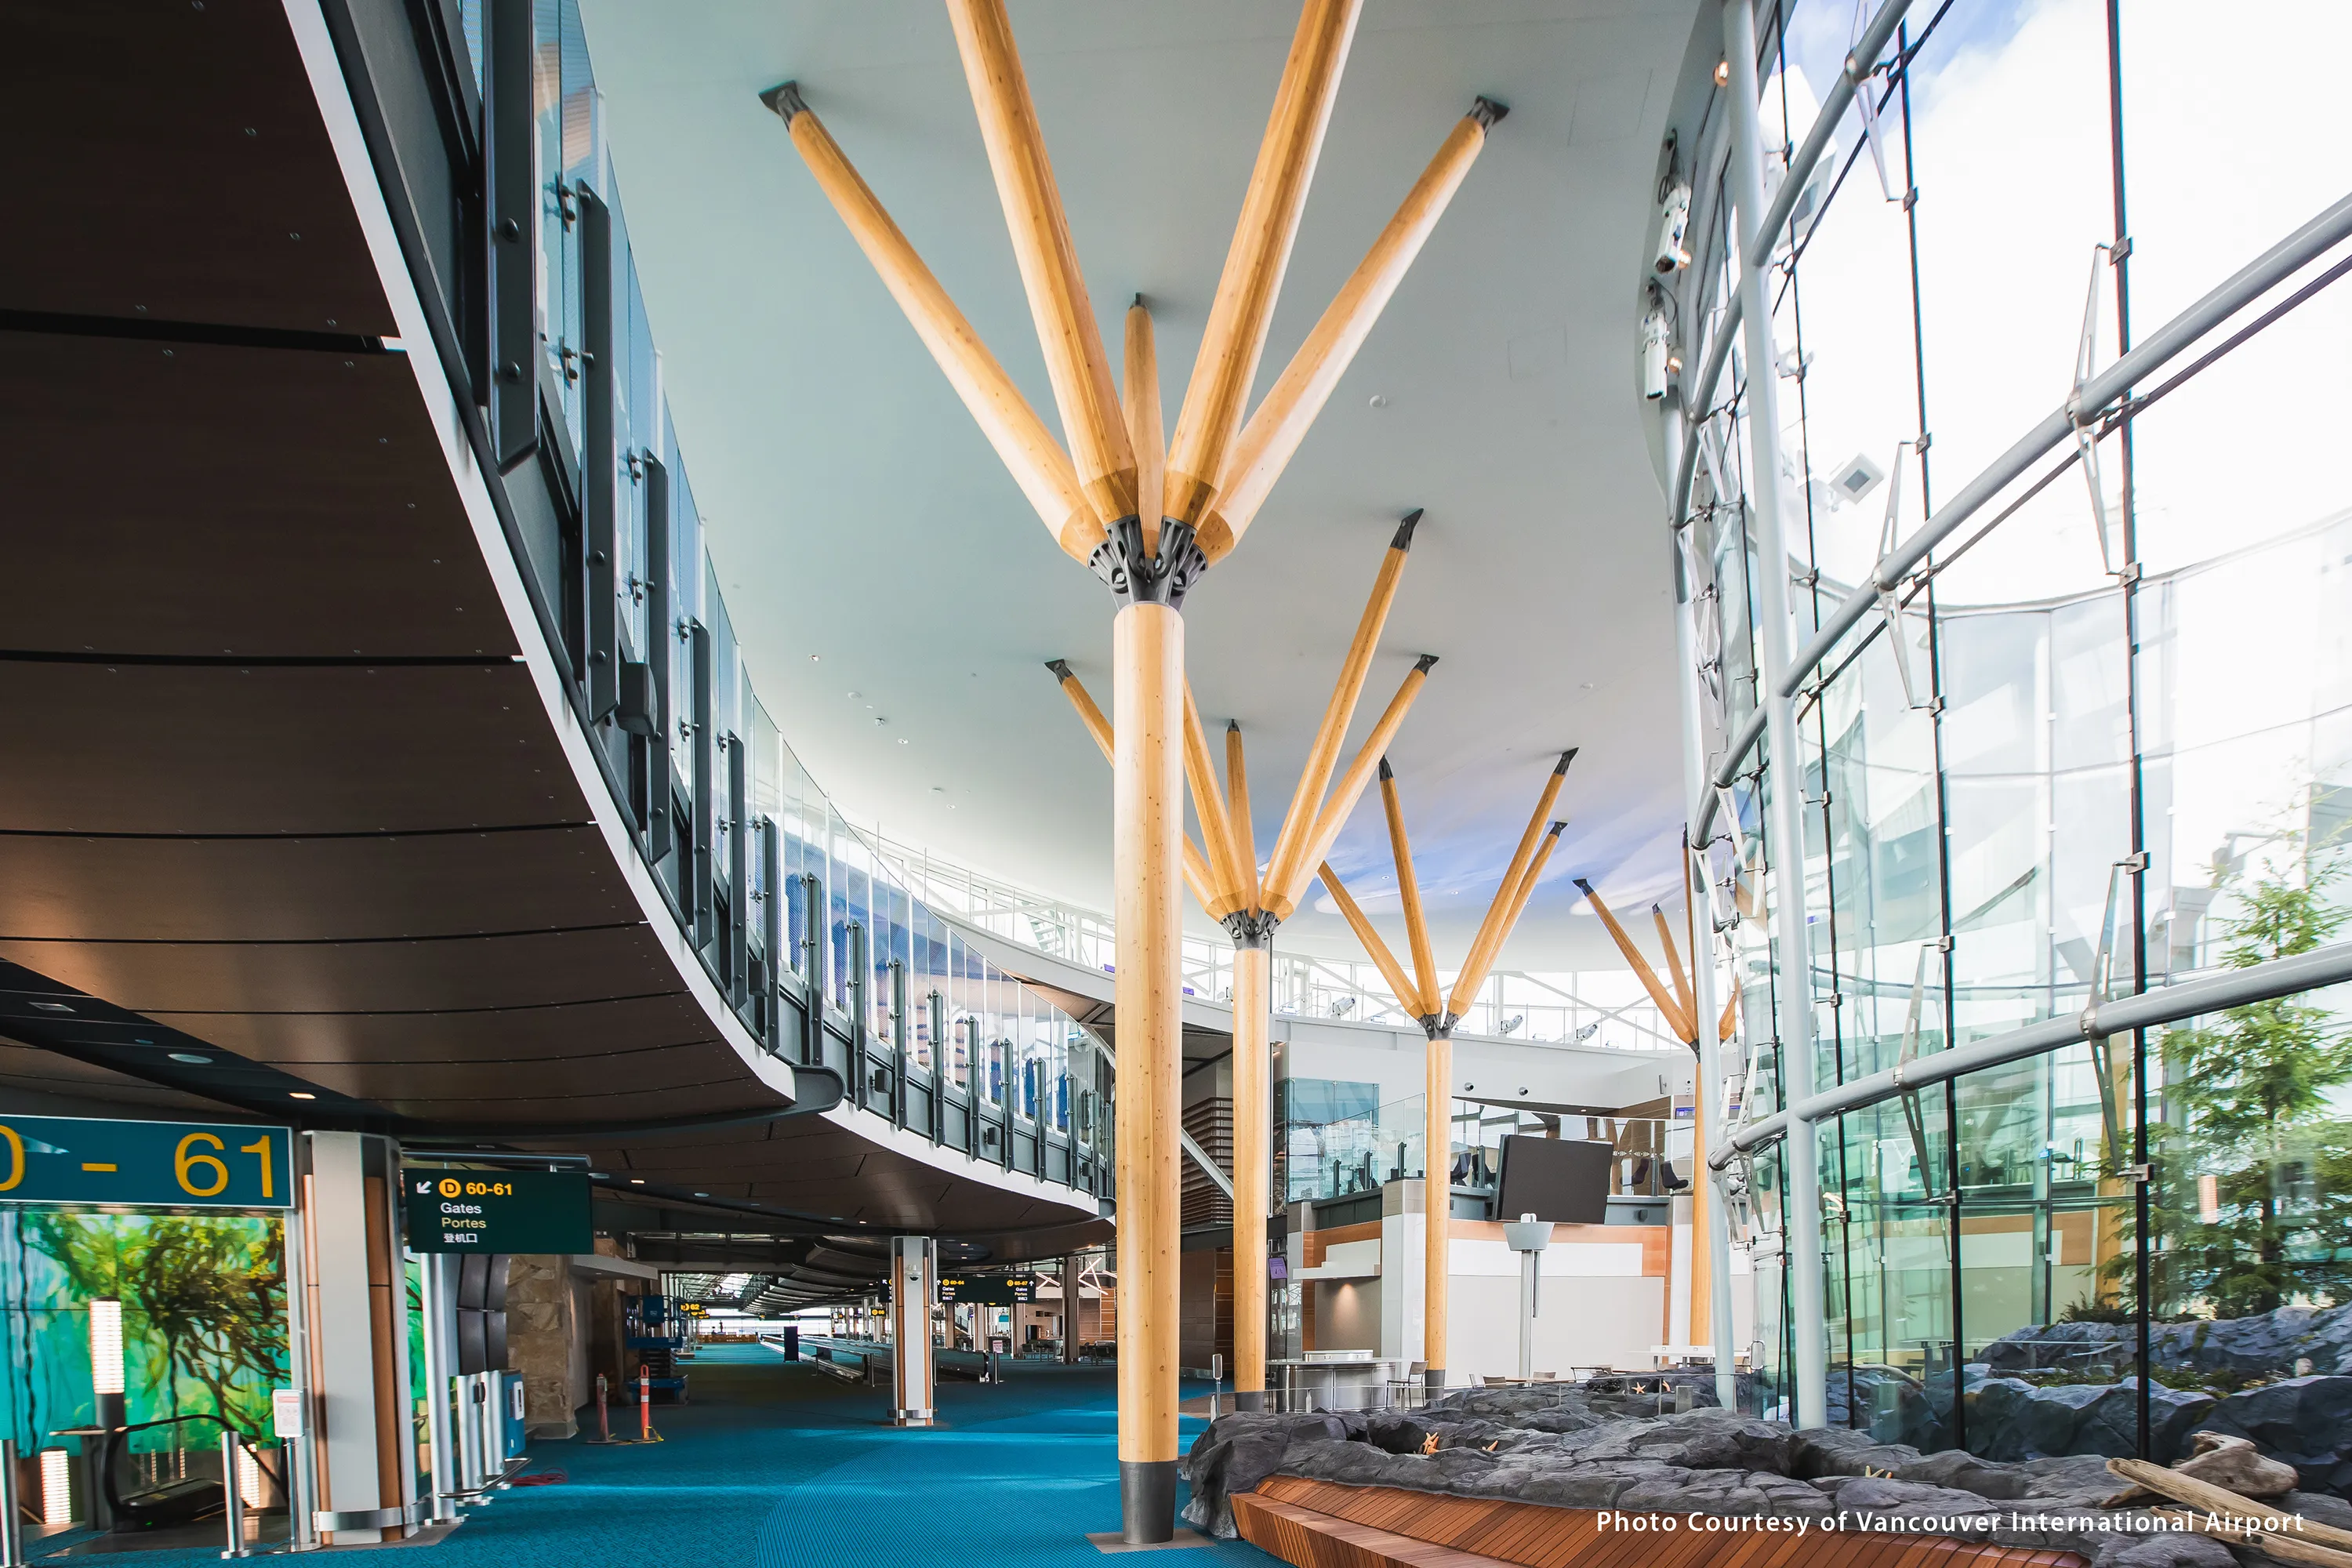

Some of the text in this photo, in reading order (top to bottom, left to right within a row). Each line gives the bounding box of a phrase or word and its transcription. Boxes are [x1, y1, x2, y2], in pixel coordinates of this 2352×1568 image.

[174, 1132, 273, 1198] 61
[466, 1182, 512, 1196] 60-61
[441, 1202, 482, 1214] Gates
[441, 1217, 487, 1229] Portes
[444, 1233, 477, 1243] 登机口
